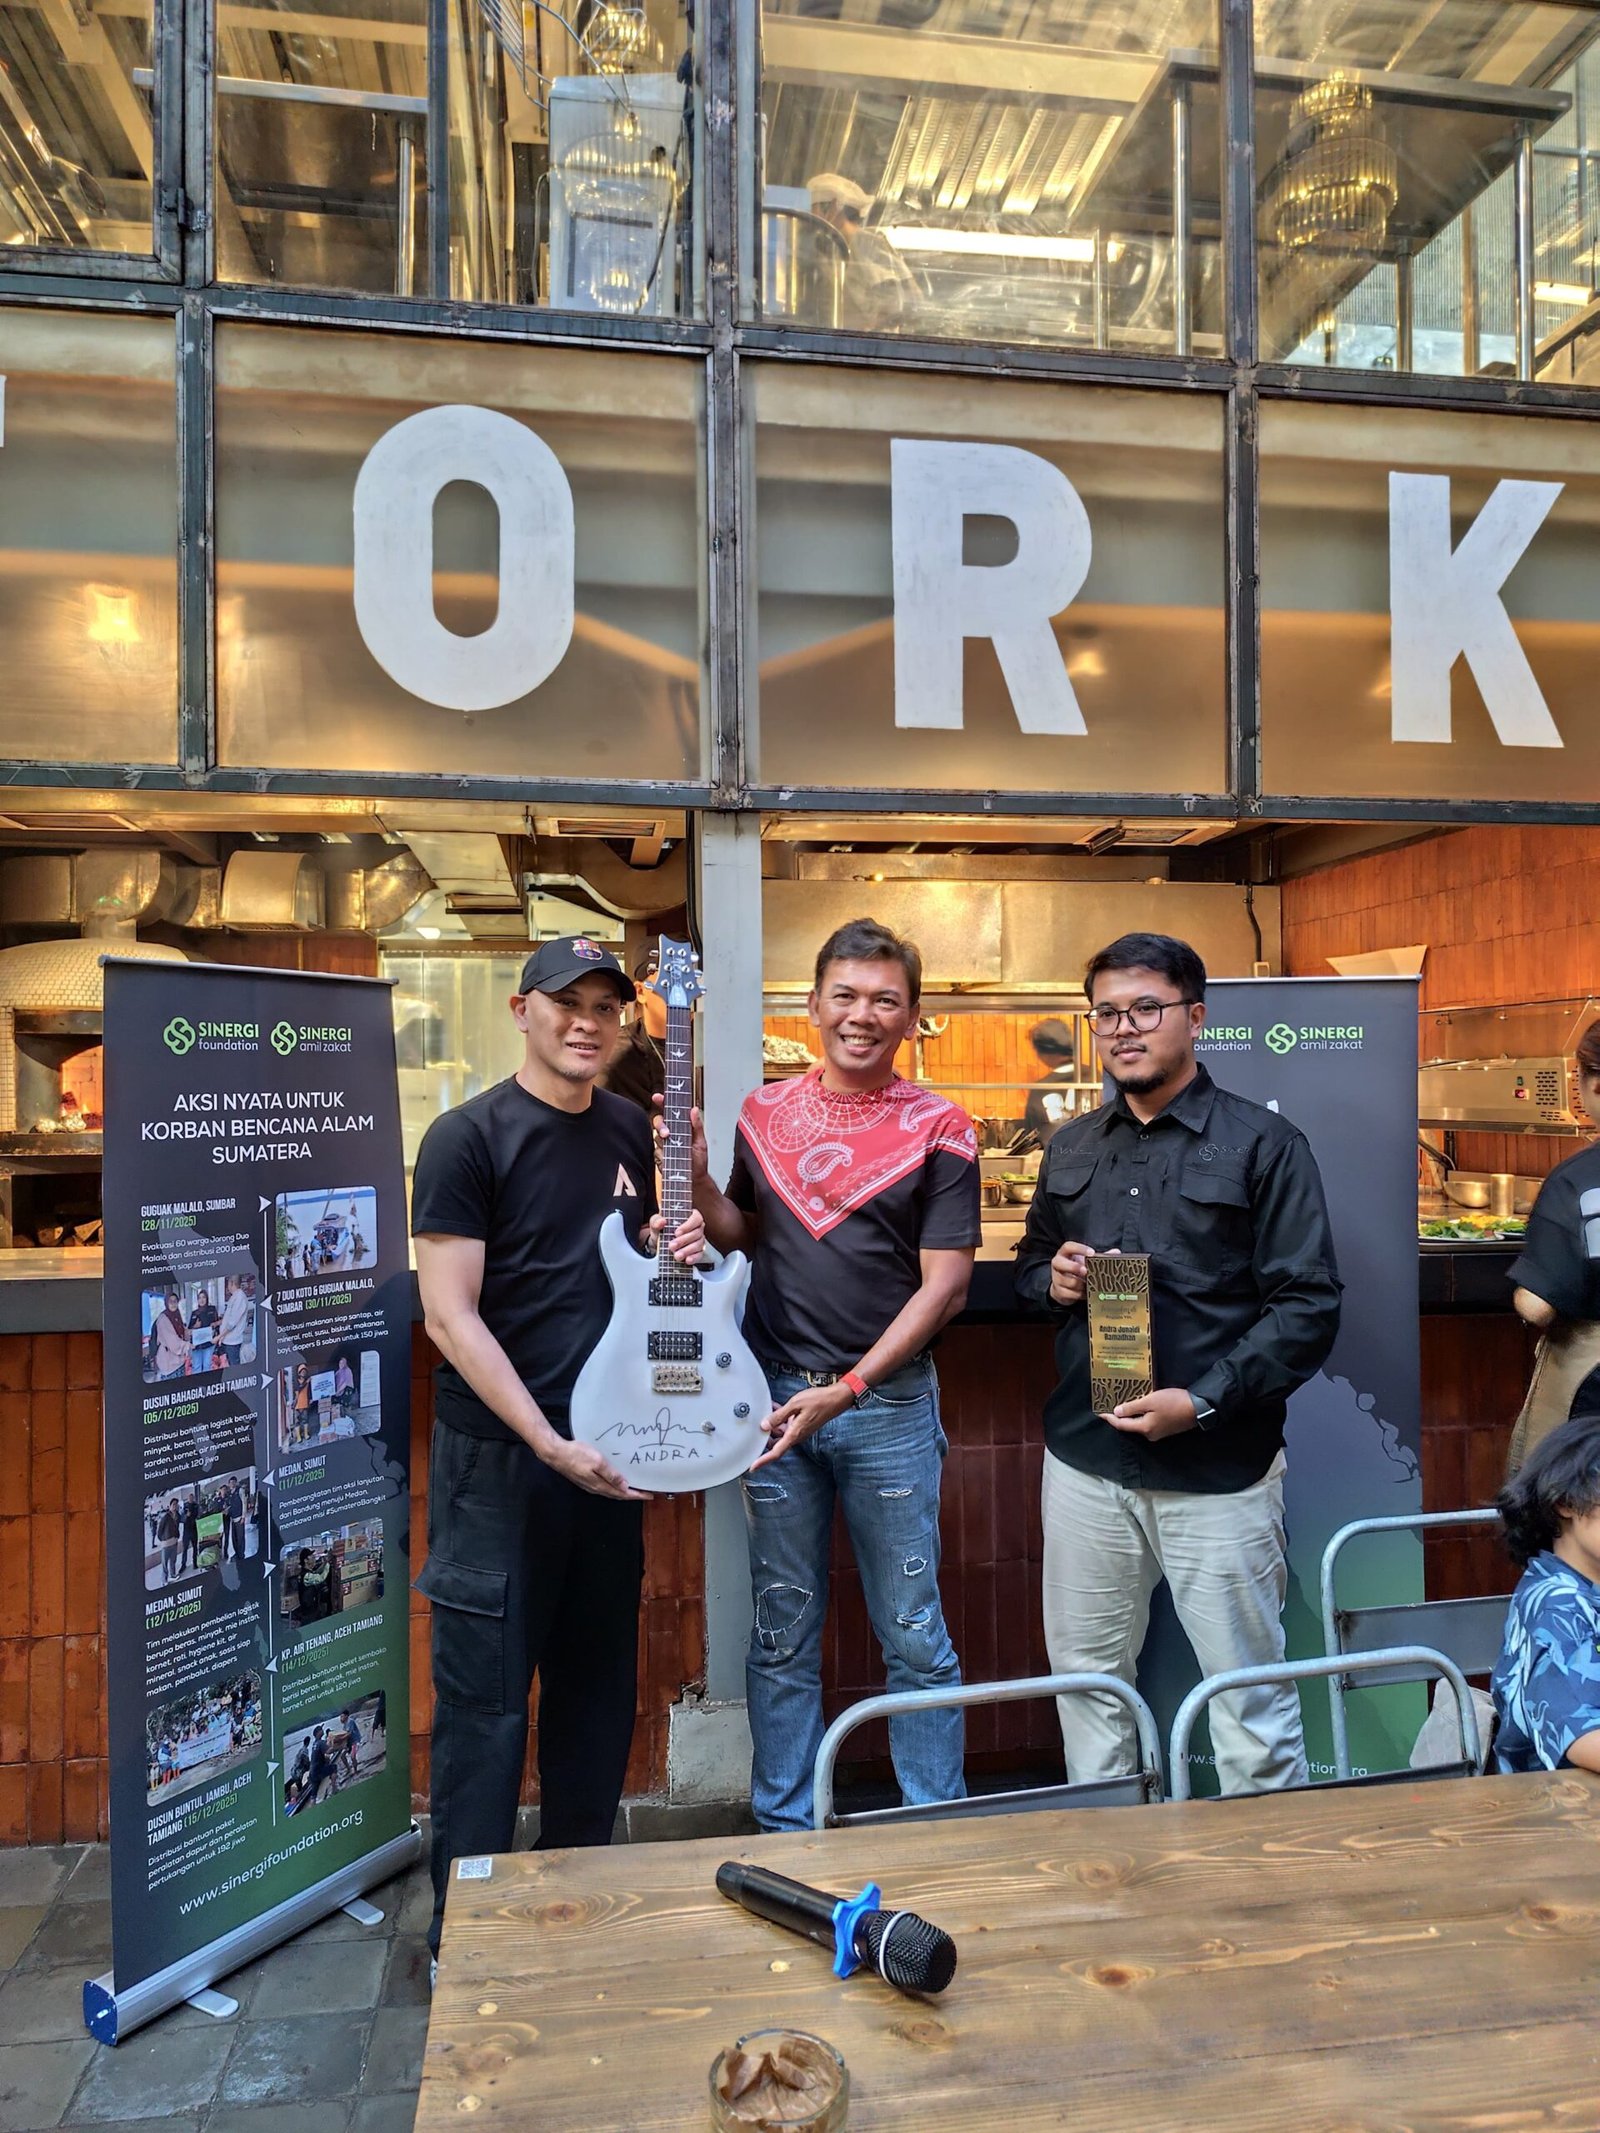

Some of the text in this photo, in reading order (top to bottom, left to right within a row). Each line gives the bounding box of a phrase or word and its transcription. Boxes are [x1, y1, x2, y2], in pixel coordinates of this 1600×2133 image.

[0, 375, 1565, 747] ORK
[198, 1022, 259, 1038] SINERGI
[300, 1027, 351, 1041] SINERGI
[1199, 1027, 1252, 1039] INERGI
[1300, 1027, 1363, 1039] SINERGI
[198, 1039, 258, 1050] foundation
[300, 1042, 351, 1052] amil zakat
[1194, 1041, 1251, 1051] oundation
[1300, 1040, 1363, 1050] amil zakat
[174, 1091, 344, 1112] AKSI NYATA UNTUK
[141, 1115, 374, 1140] KORBAN BENCANA ALAM
[212, 1142, 312, 1164] SUMATERA
[141, 1198, 235, 1217] GUGUAK MALALO, SUMBAR
[141, 1216, 196, 1231] (28/11/2025)
[277, 1278, 374, 1301] 7 DUO KOTO & GUGUAK MALALO,
[277, 1293, 351, 1314] SUMBAR (30/11/2025)
[144, 1376, 256, 1410] DUSUN BAHAGIA, ACEH TAMIANG
[144, 1402, 199, 1424] (05/12/2025)
[279, 1455, 326, 1478] MEDAN, SUMUT
[146, 1586, 202, 1615] MEDAN, SUMUT
[146, 1601, 201, 1629] (12/12/2025)
[281, 1614, 383, 1661] KP. AIR TENANG, ACEH TAMIANG
[148, 1772, 252, 1832] DUSUN BUNTUL JAMBU, ACEH
[148, 1793, 238, 1846] TAMIANG (15/12/2025)
[180, 1809, 363, 1914] www.sinergifoundation.org
